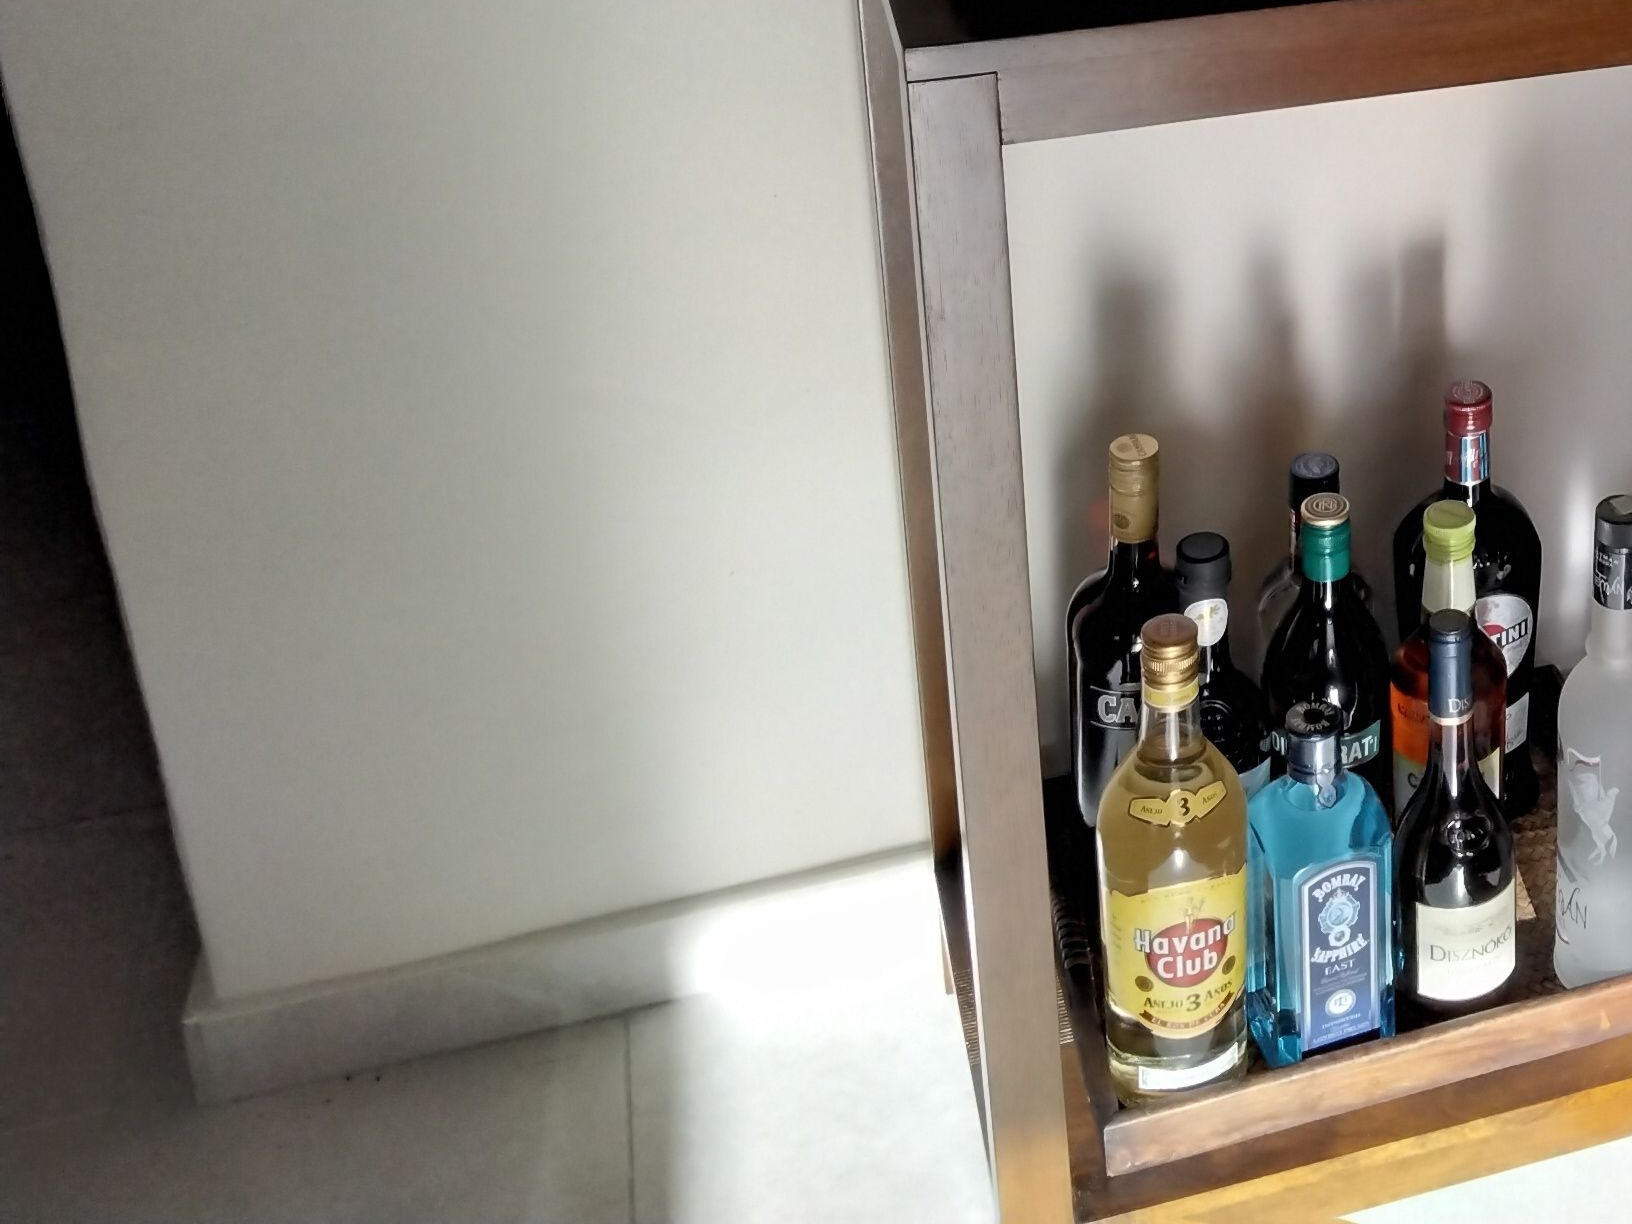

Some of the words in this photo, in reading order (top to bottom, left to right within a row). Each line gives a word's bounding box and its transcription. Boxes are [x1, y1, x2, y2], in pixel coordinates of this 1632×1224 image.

[1488, 617, 1528, 648] TINI
[1177, 797, 1190, 817] 3
[1312, 873, 1366, 903] BOMBAY
[1133, 913, 1237, 954] Havana
[1157, 948, 1218, 979] Club
[1325, 958, 1355, 976] EAST
[1186, 993, 1201, 1012] 3
